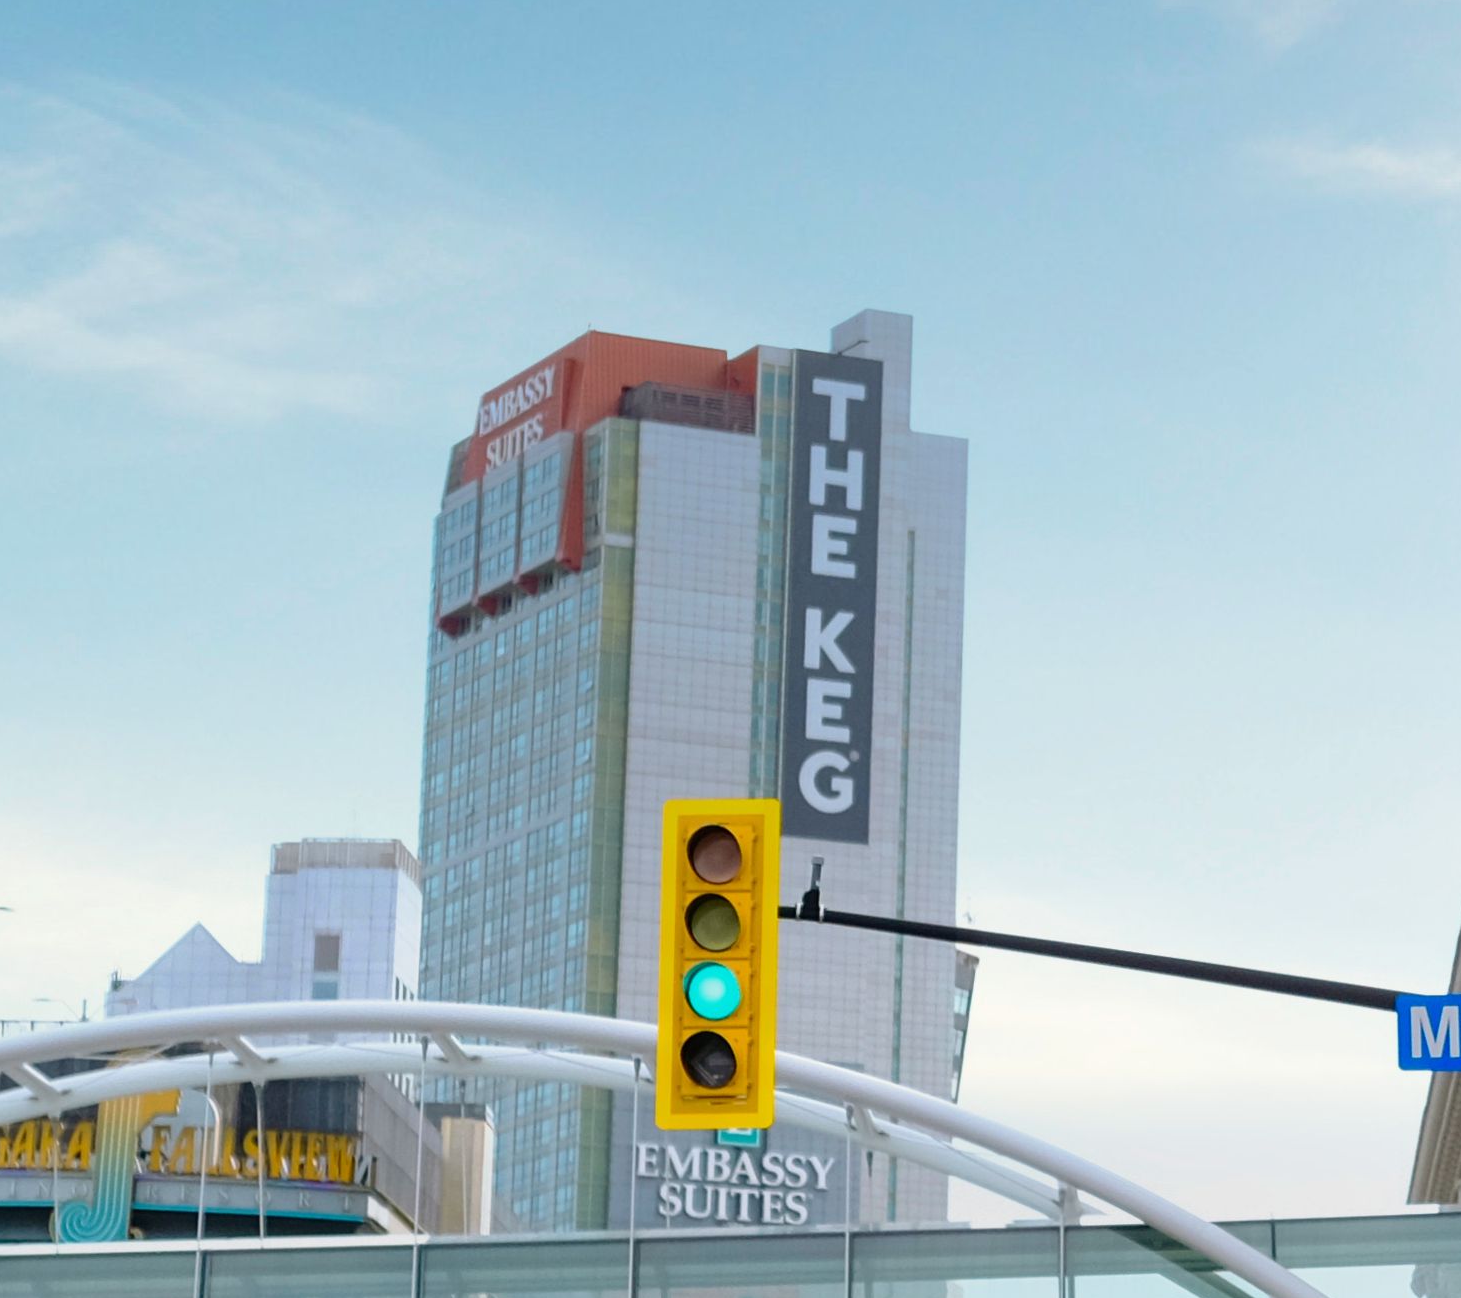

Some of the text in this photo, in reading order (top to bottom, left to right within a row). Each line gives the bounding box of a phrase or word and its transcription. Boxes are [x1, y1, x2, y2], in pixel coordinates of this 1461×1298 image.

[478, 362, 556, 438] EMBASSY
[485, 412, 545, 473] SUITES
[808, 376, 866, 579] THE
[797, 606, 856, 815] KEG
[636, 1142, 835, 1191] EMBASSY
[658, 1182, 809, 1226] SUITES
